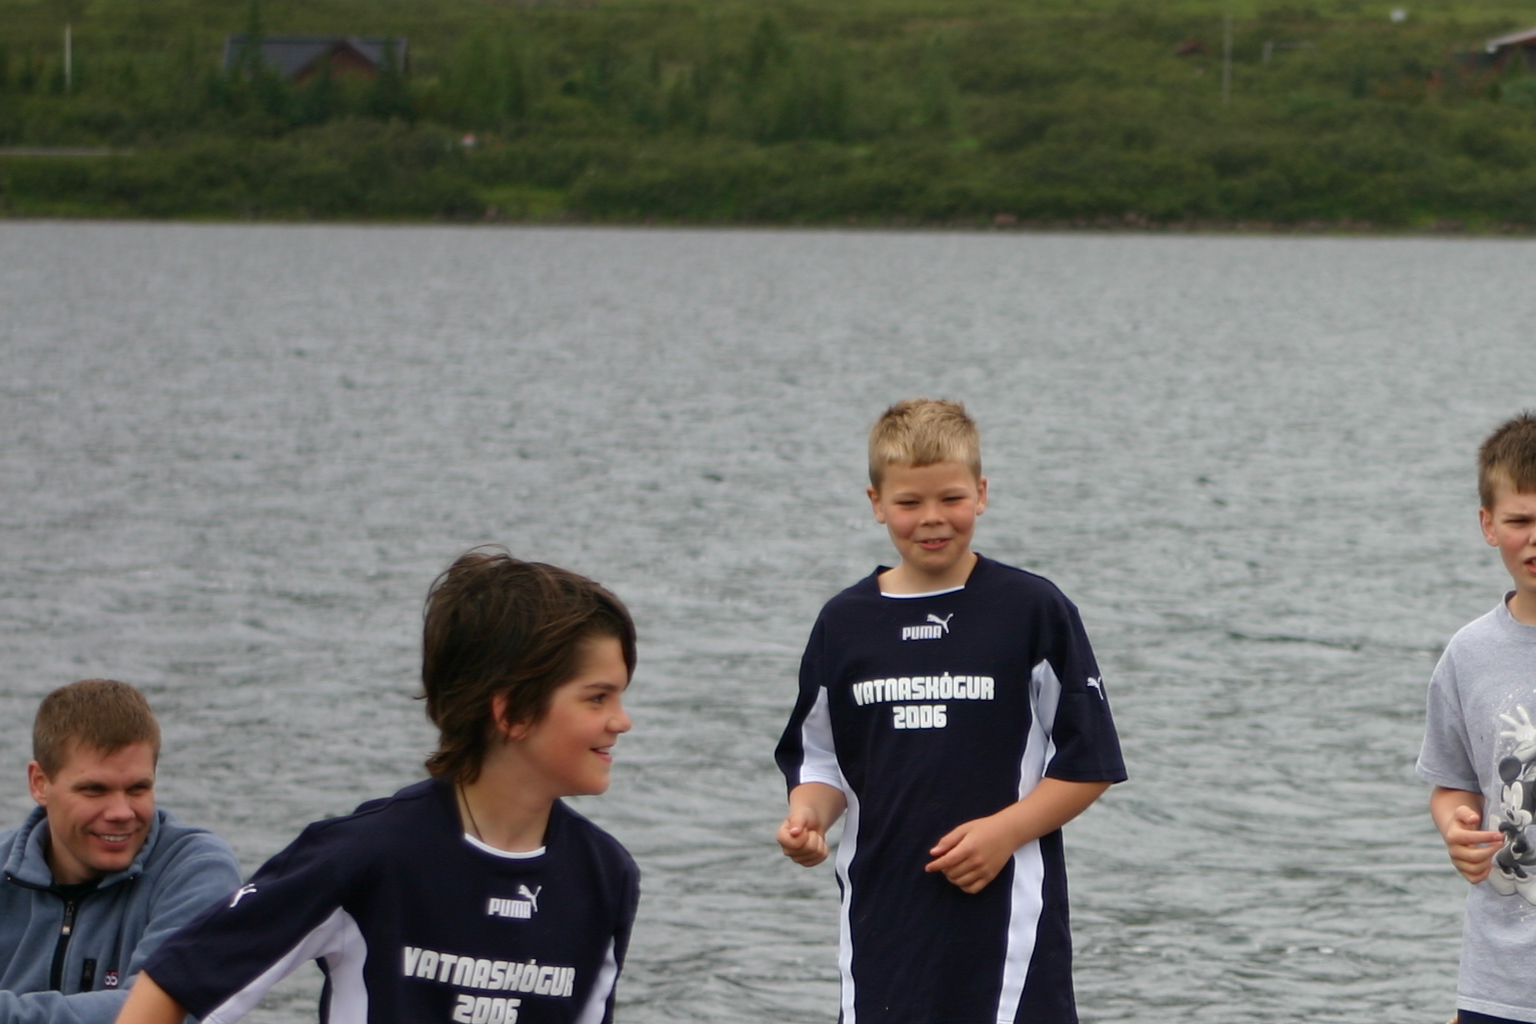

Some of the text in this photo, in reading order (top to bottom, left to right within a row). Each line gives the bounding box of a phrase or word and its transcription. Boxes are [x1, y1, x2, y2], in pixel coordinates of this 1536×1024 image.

[902, 625, 942, 641] PUMA
[852, 671, 995, 706] VATNASKÓGUR
[893, 704, 947, 730] 2006
[487, 898, 532, 919] PUMA
[403, 946, 576, 997] VATNASKÓGUR
